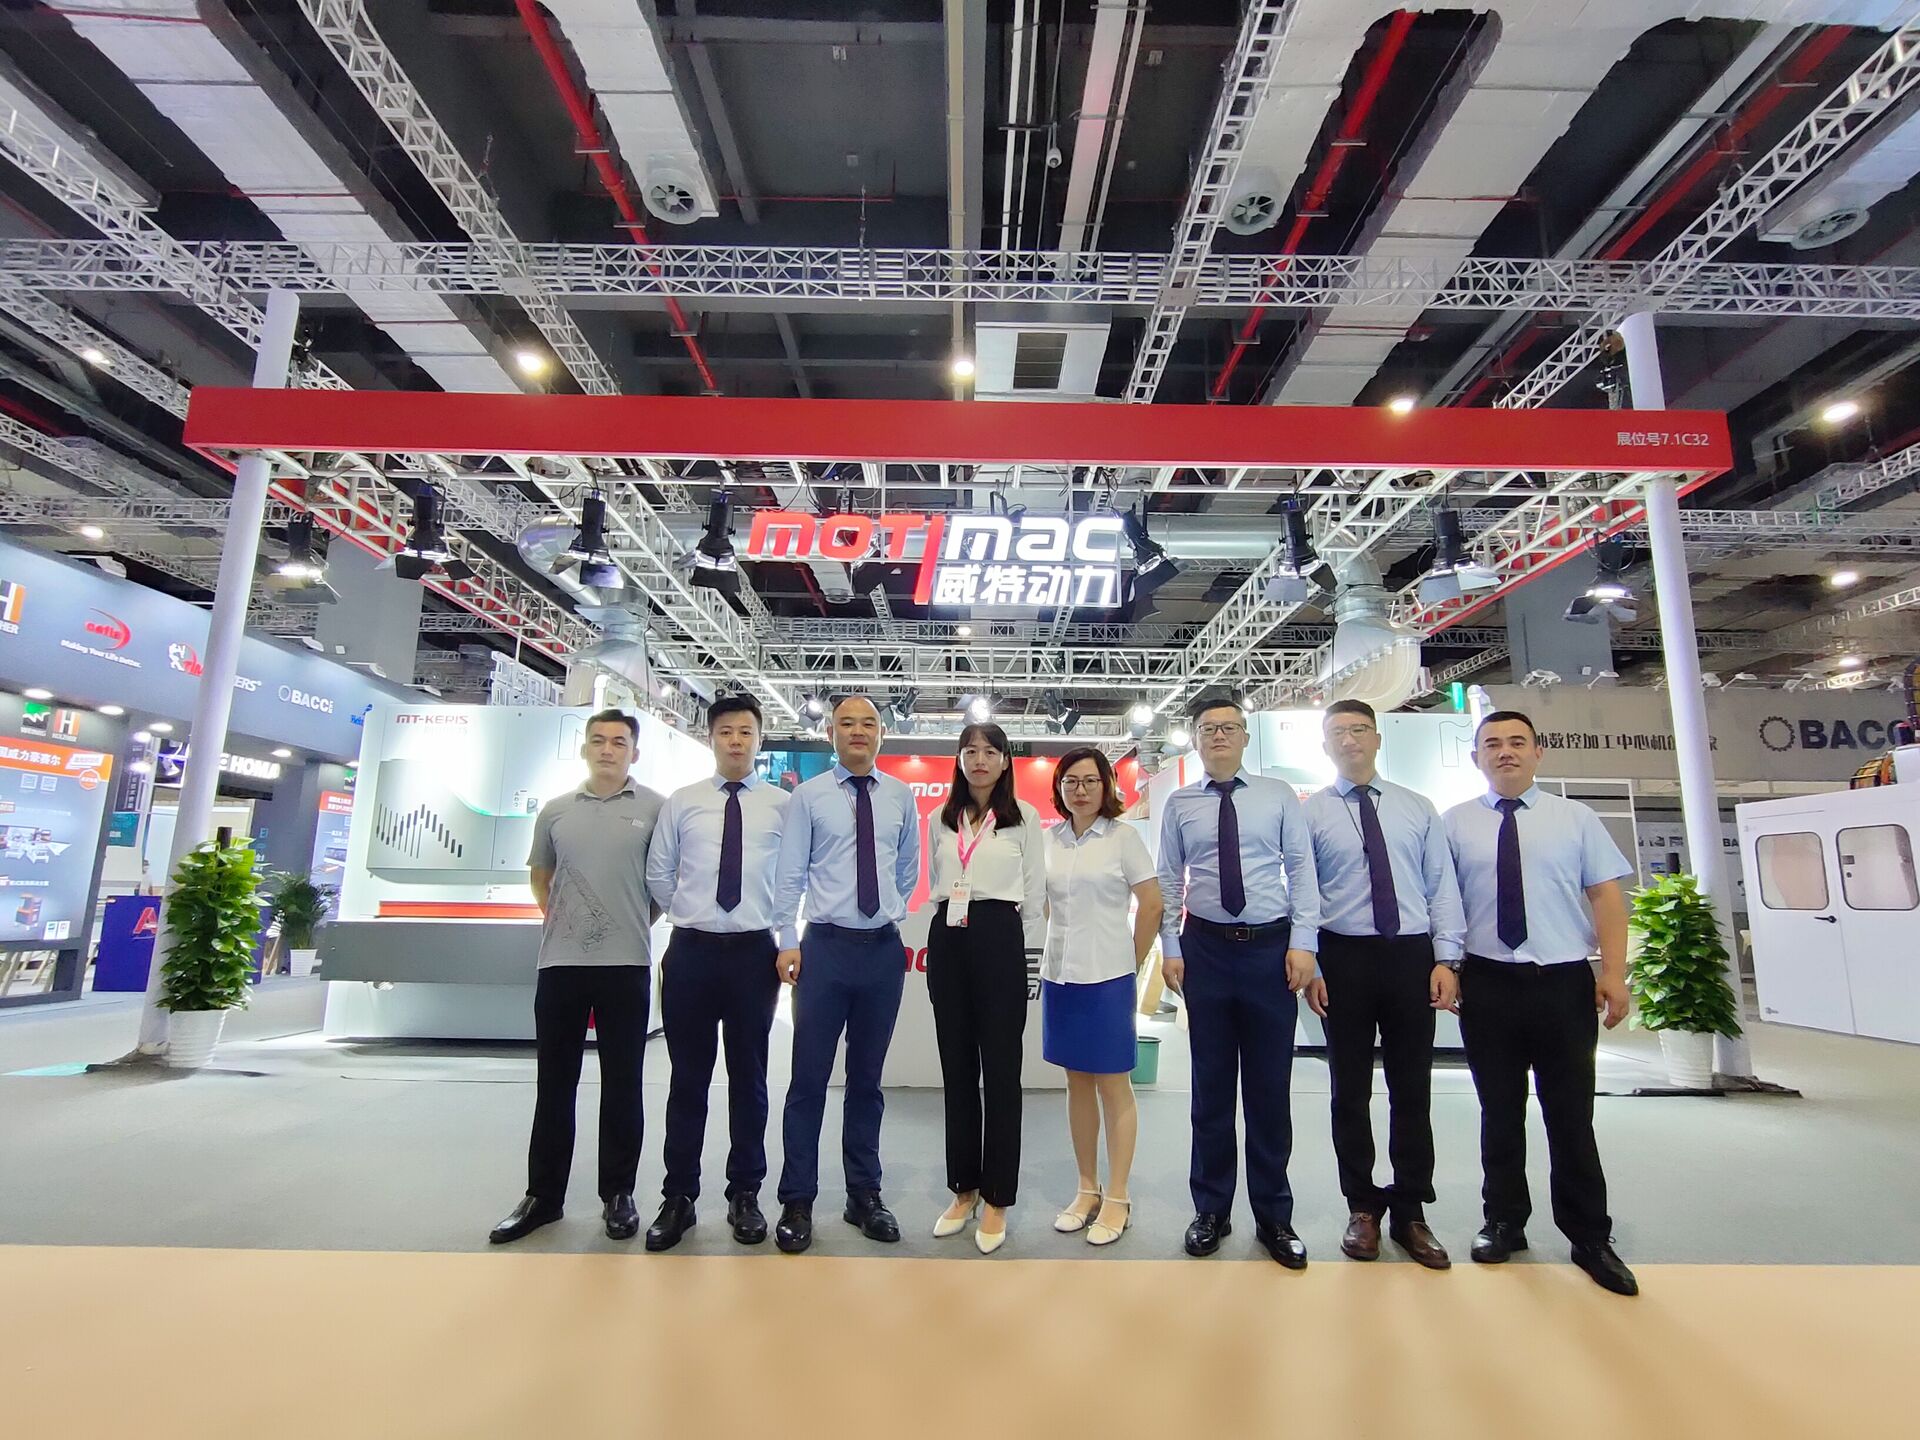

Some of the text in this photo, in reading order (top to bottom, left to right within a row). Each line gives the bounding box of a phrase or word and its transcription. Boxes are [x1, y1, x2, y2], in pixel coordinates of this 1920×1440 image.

[1617, 431, 1710, 446] 展位号7.1C32
[933, 563, 1117, 606] 威特动力
